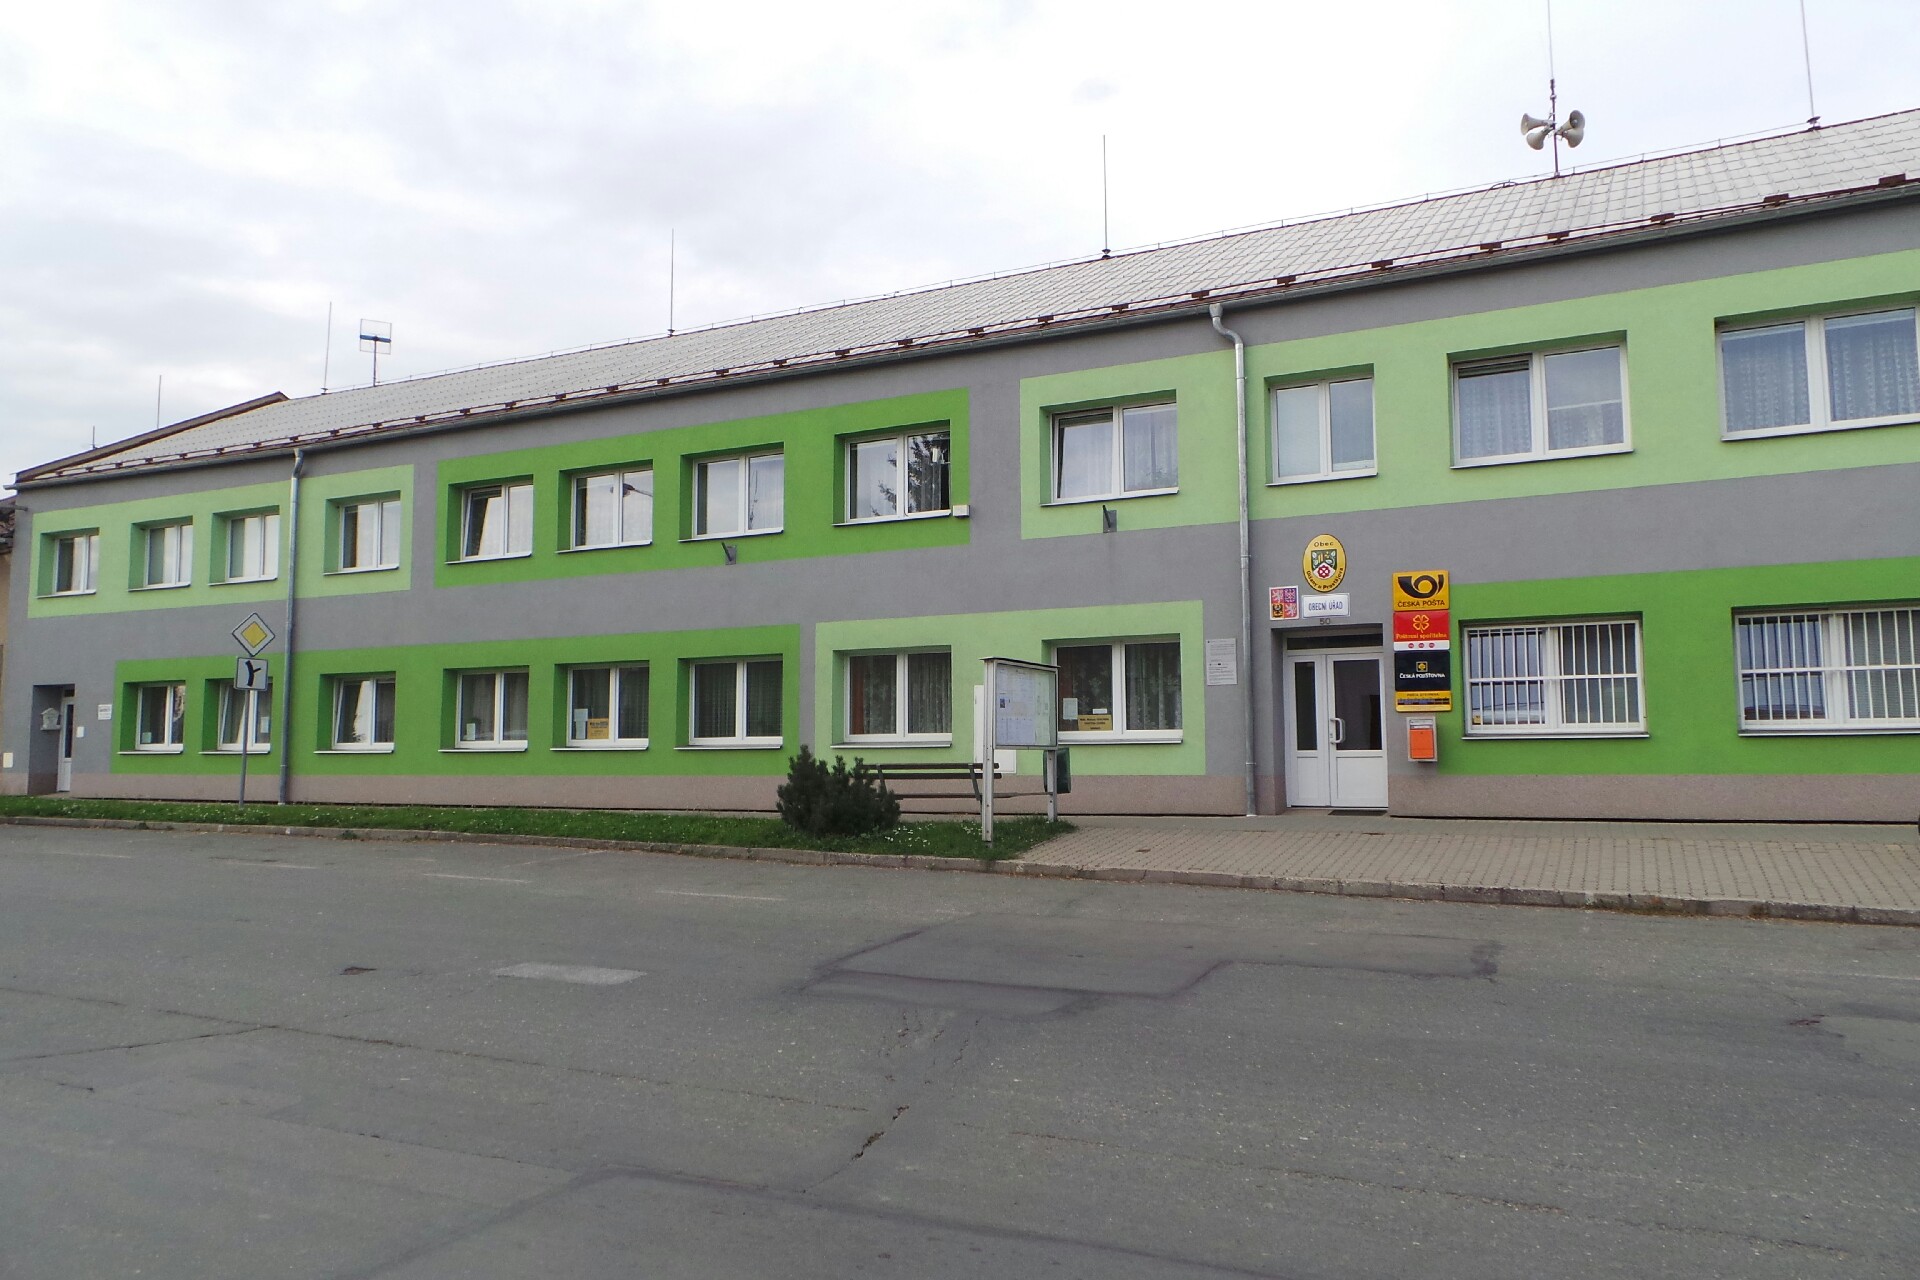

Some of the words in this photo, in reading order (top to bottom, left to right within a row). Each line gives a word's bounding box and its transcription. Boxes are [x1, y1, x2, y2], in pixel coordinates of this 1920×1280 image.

[1308, 601, 1327, 612] OBECNÍ
[1328, 600, 1344, 611] ÚŘAD
[1397, 600, 1420, 608] ČESKÁ
[1422, 598, 1446, 607] POŠTA
[1319, 617, 1331, 626] 50
